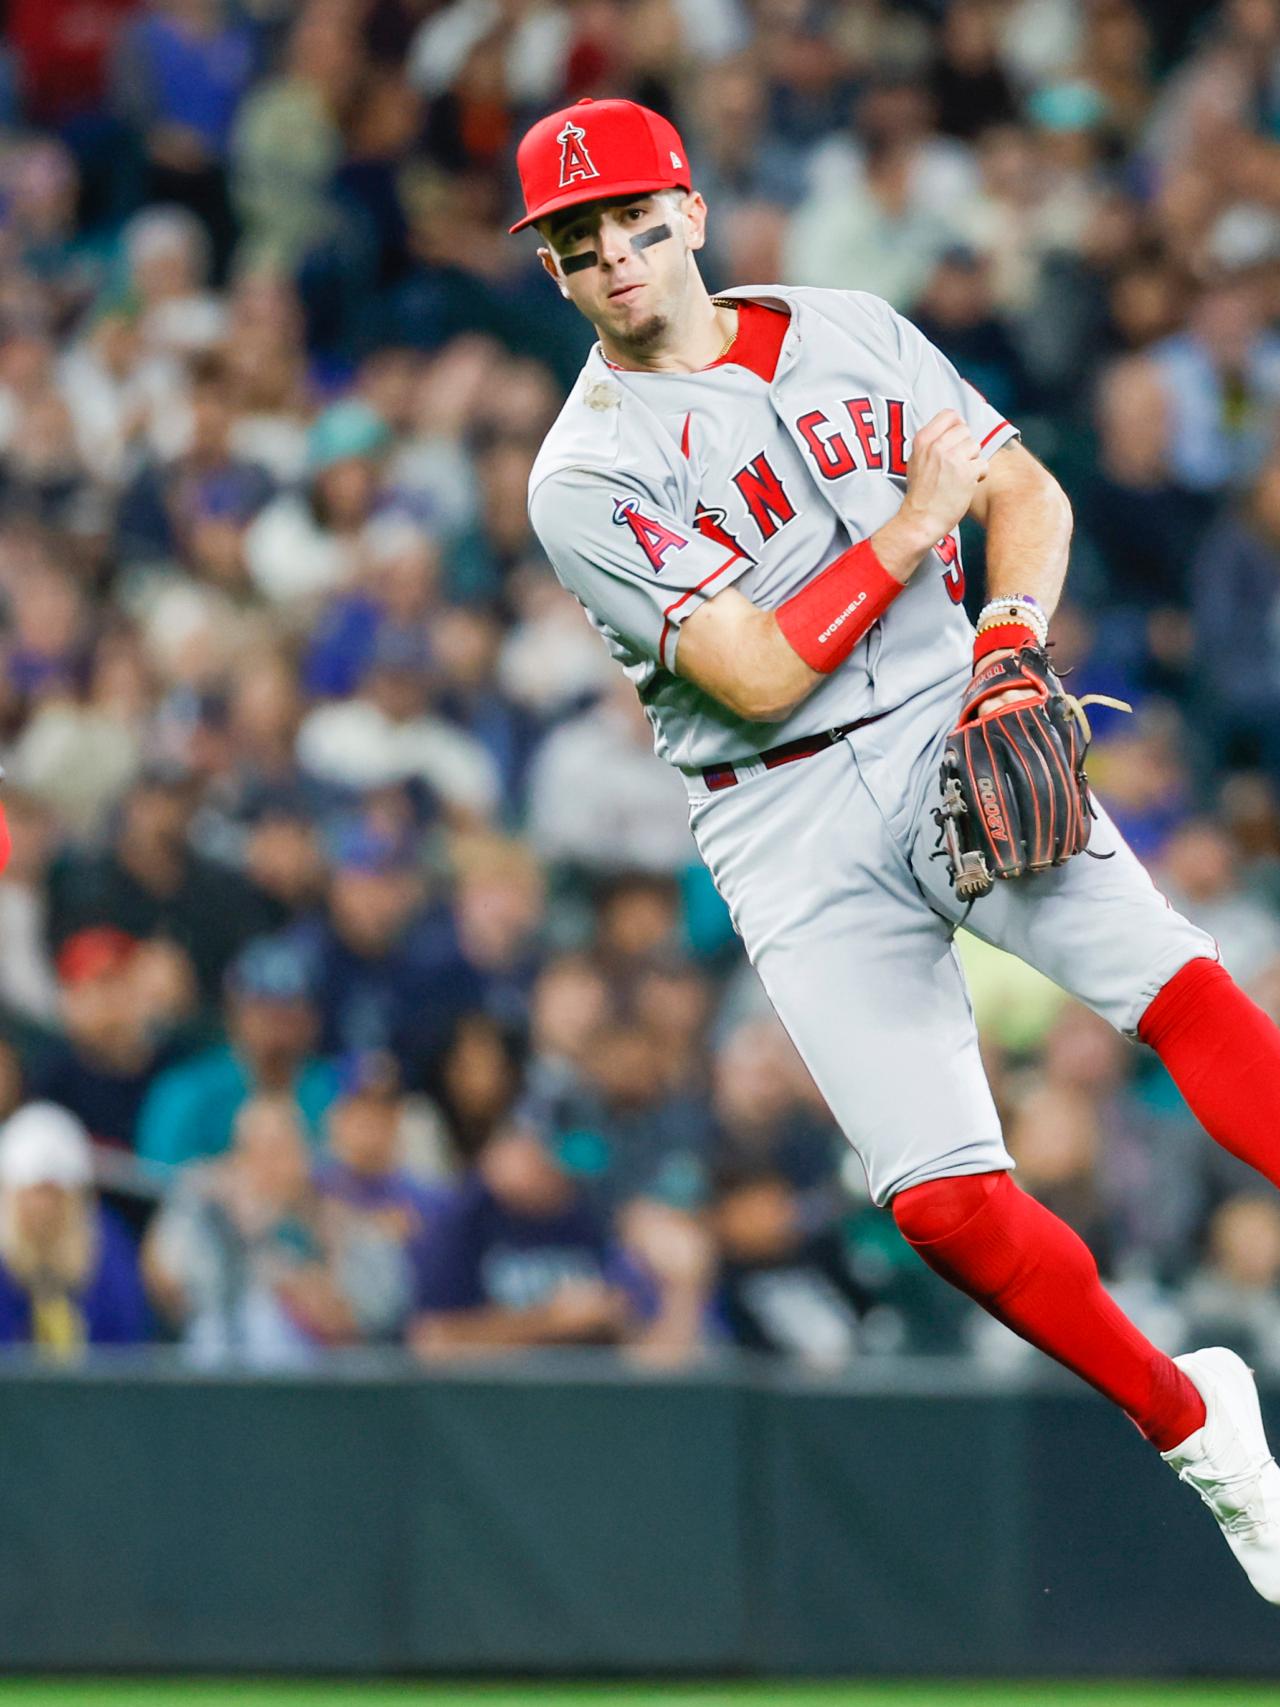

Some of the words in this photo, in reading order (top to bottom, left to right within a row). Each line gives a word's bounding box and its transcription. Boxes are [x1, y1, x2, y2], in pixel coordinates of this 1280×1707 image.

[557, 120, 600, 188] A
[690, 396, 911, 566] NGEL
[610, 496, 689, 576] A
[818, 591, 867, 643] EVOSHIELD
[977, 777, 1009, 841] A2000
